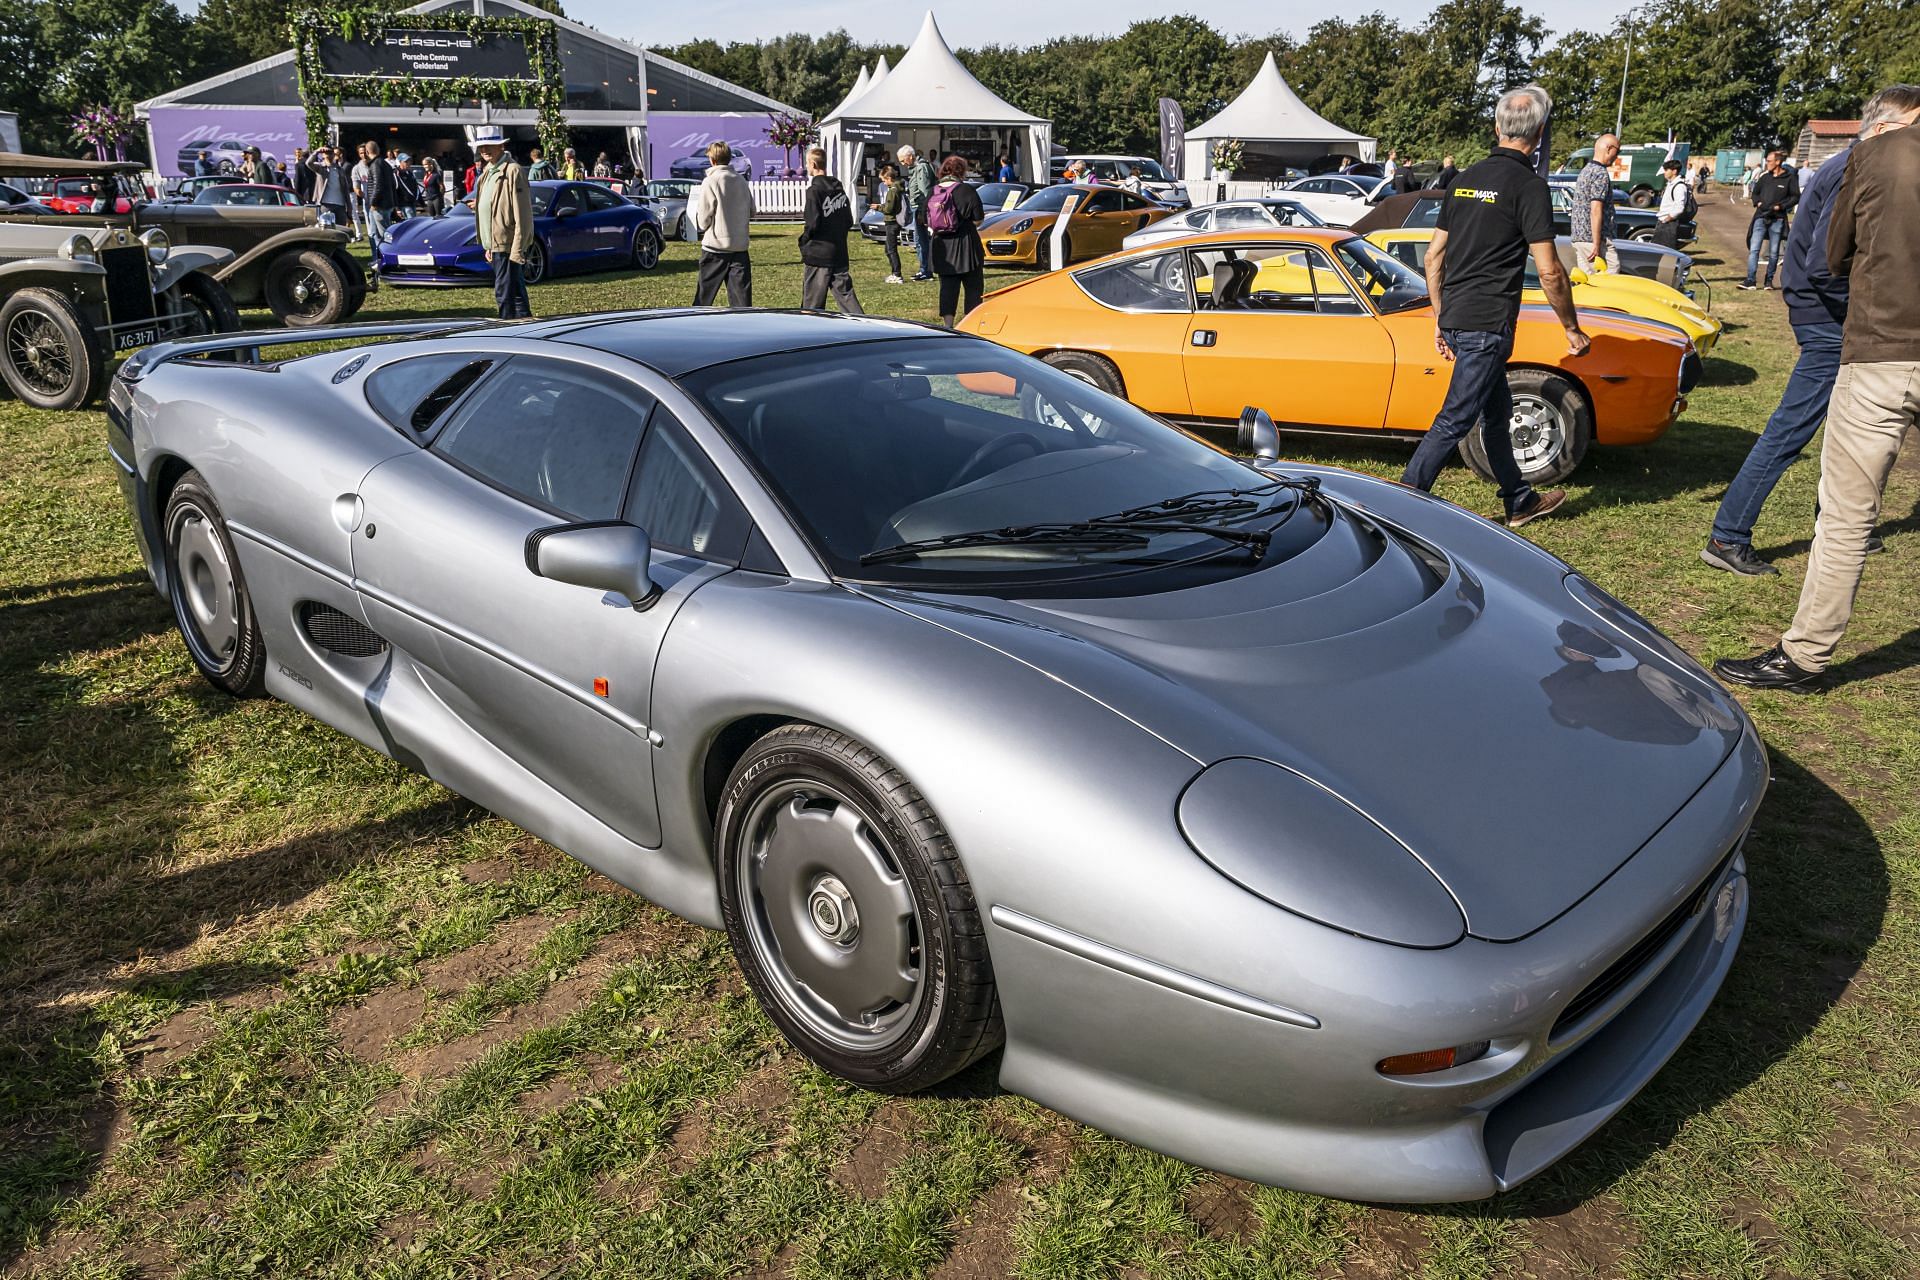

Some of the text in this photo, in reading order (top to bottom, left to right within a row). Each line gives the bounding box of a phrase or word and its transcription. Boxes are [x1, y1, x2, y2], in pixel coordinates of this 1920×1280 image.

[385, 38, 472, 48] PORSCHE
[429, 53, 458, 61] Centrum
[413, 61, 448, 70] Gelderland
[179, 125, 296, 141] Macan
[120, 330, 154, 348] XG-31-71
